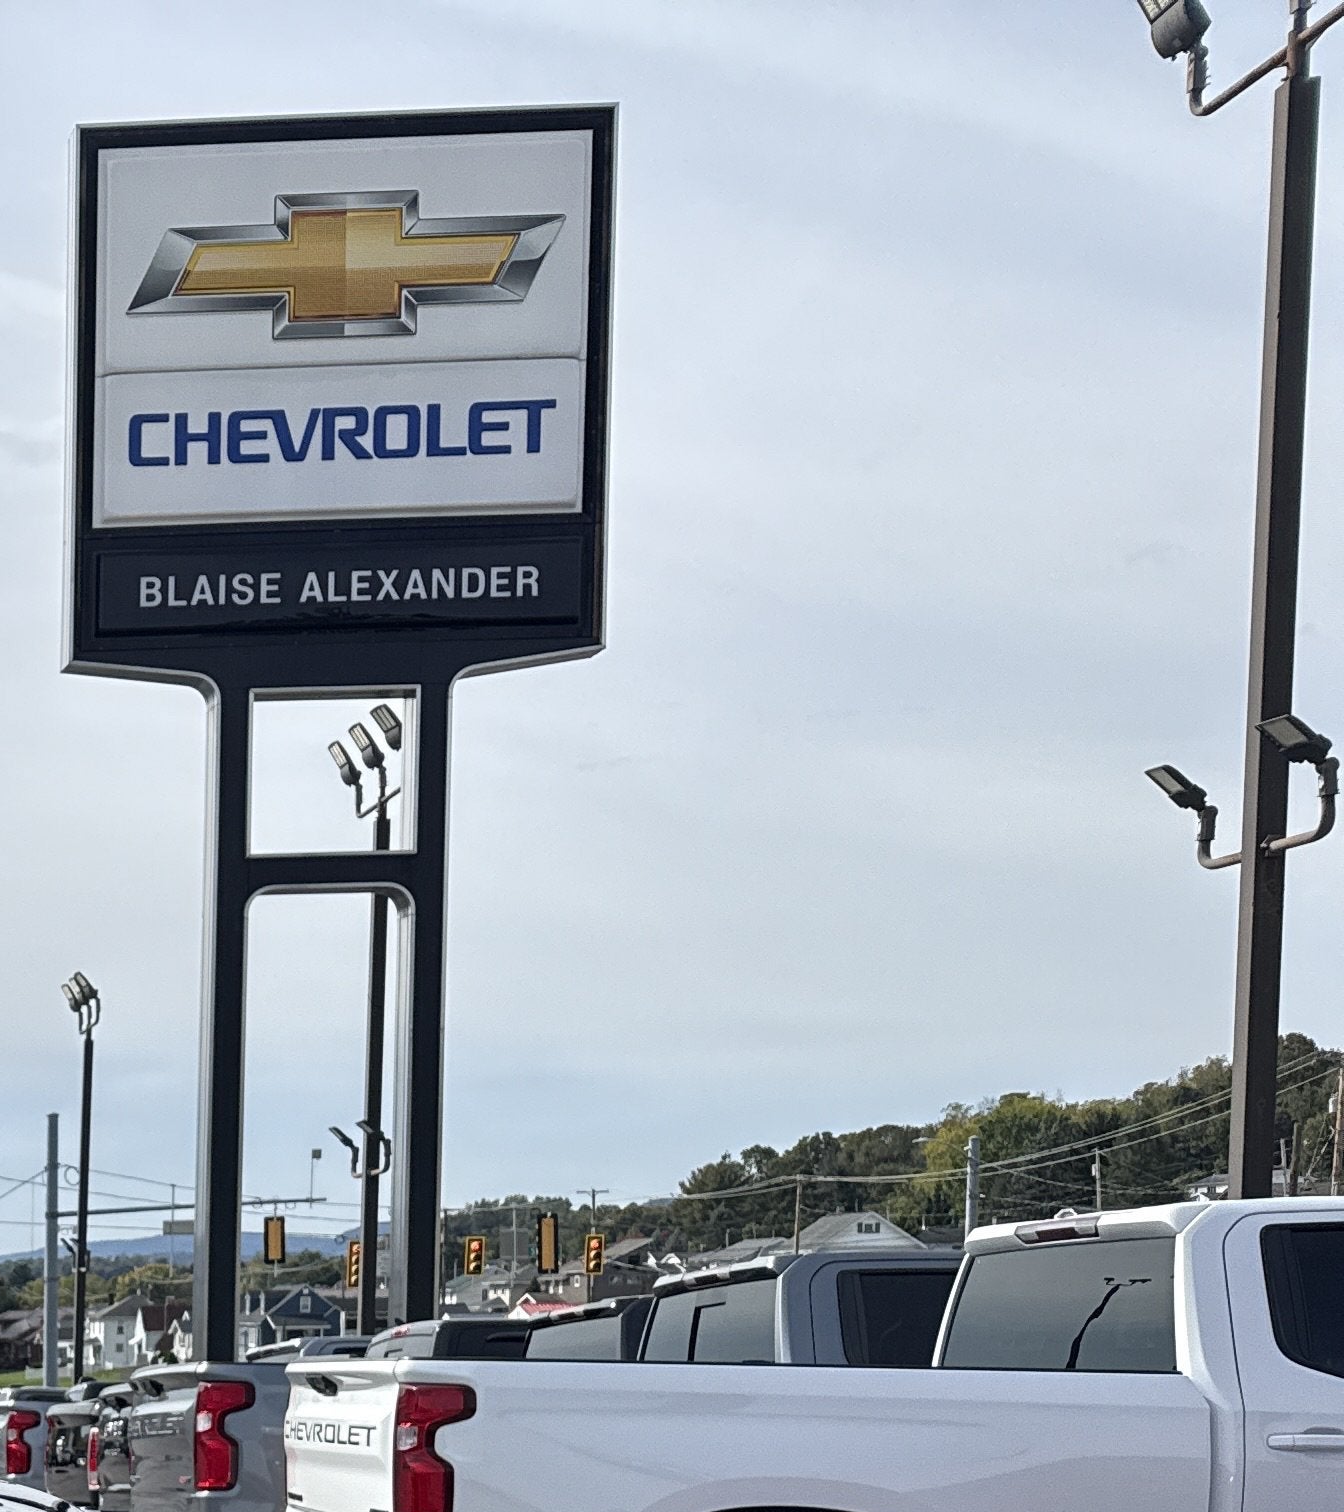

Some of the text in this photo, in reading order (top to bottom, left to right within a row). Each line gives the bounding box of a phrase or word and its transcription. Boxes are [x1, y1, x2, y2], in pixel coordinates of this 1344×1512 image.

[127, 399, 557, 467] CHEVROLET
[138, 565, 541, 608] BLAISE ALEXANDER
